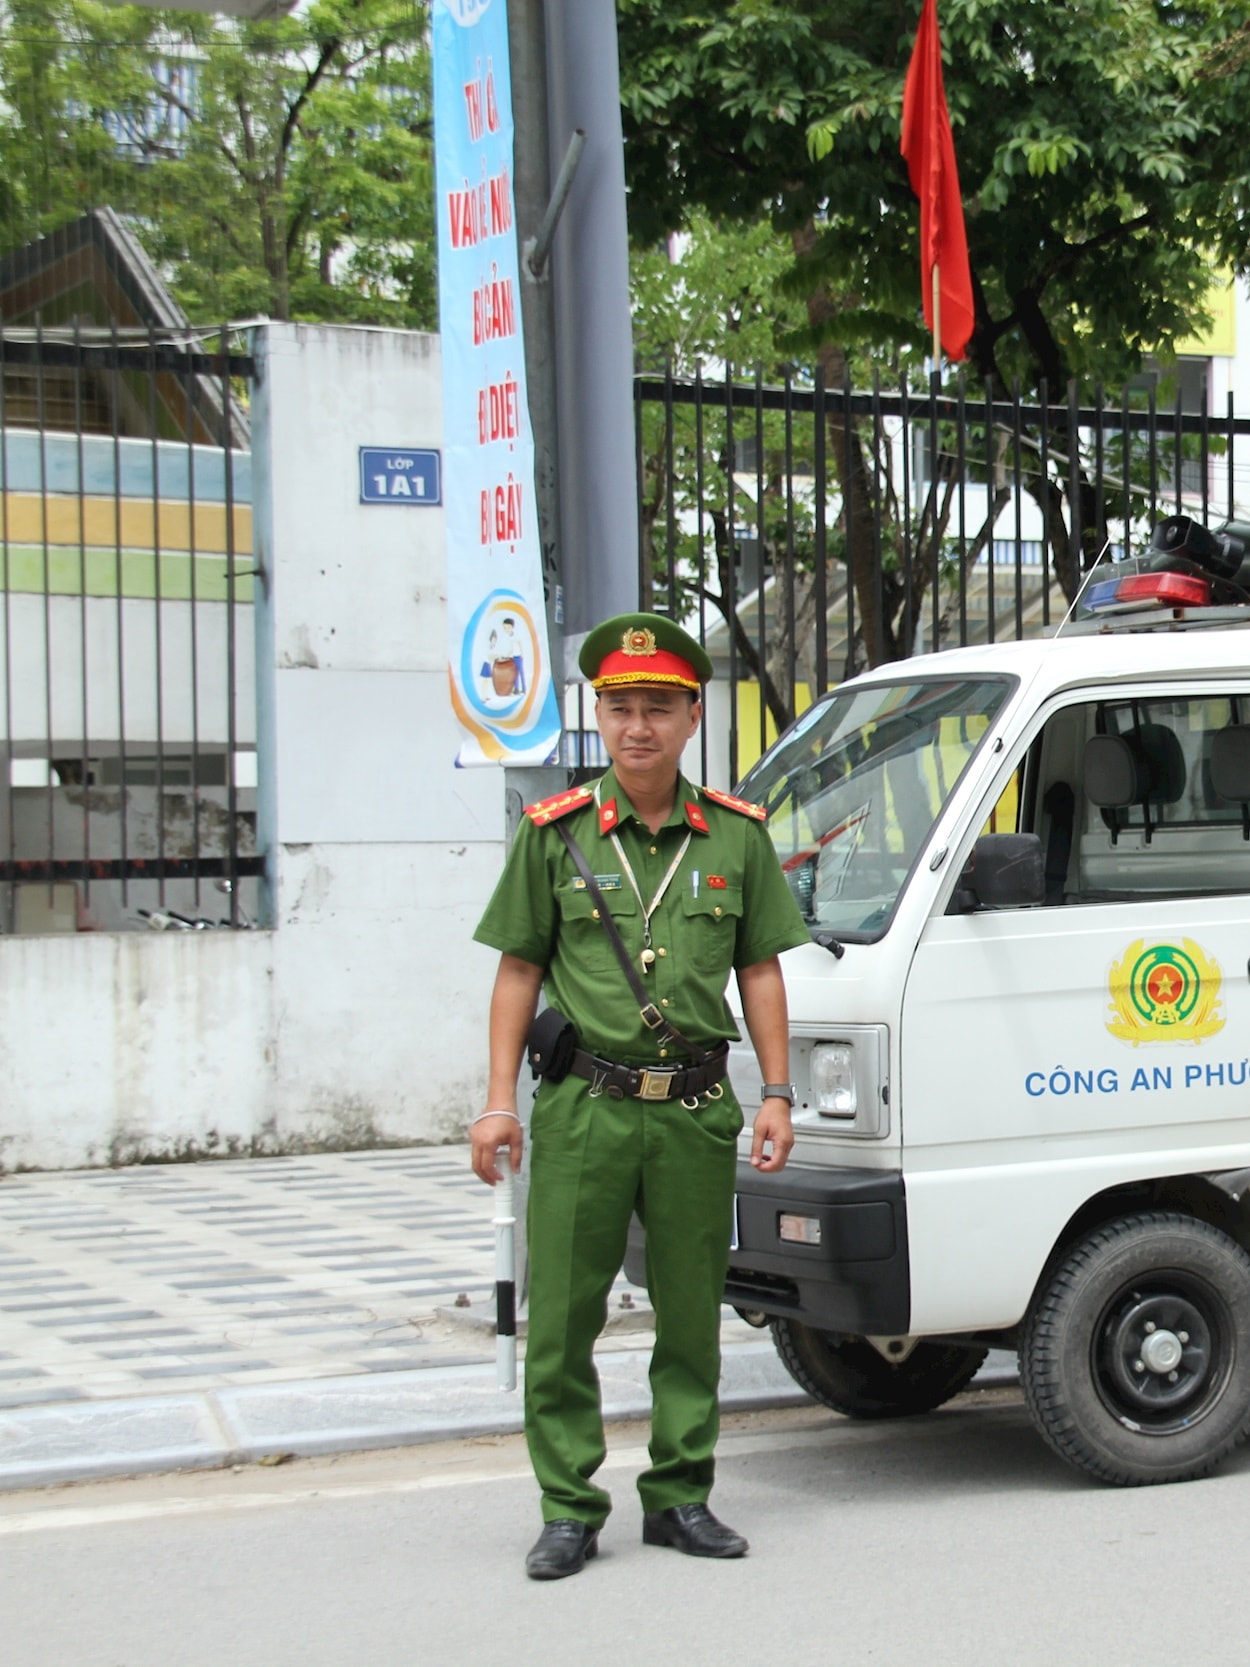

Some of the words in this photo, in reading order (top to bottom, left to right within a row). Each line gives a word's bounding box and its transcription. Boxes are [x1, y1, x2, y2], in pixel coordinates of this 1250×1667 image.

[387, 457, 414, 470] LỚP
[373, 474, 425, 497] 1A1
[495, 472, 522, 554] GẬY
[1025, 1065, 1118, 1096] CÔNG
[1130, 1066, 1172, 1091] AN
